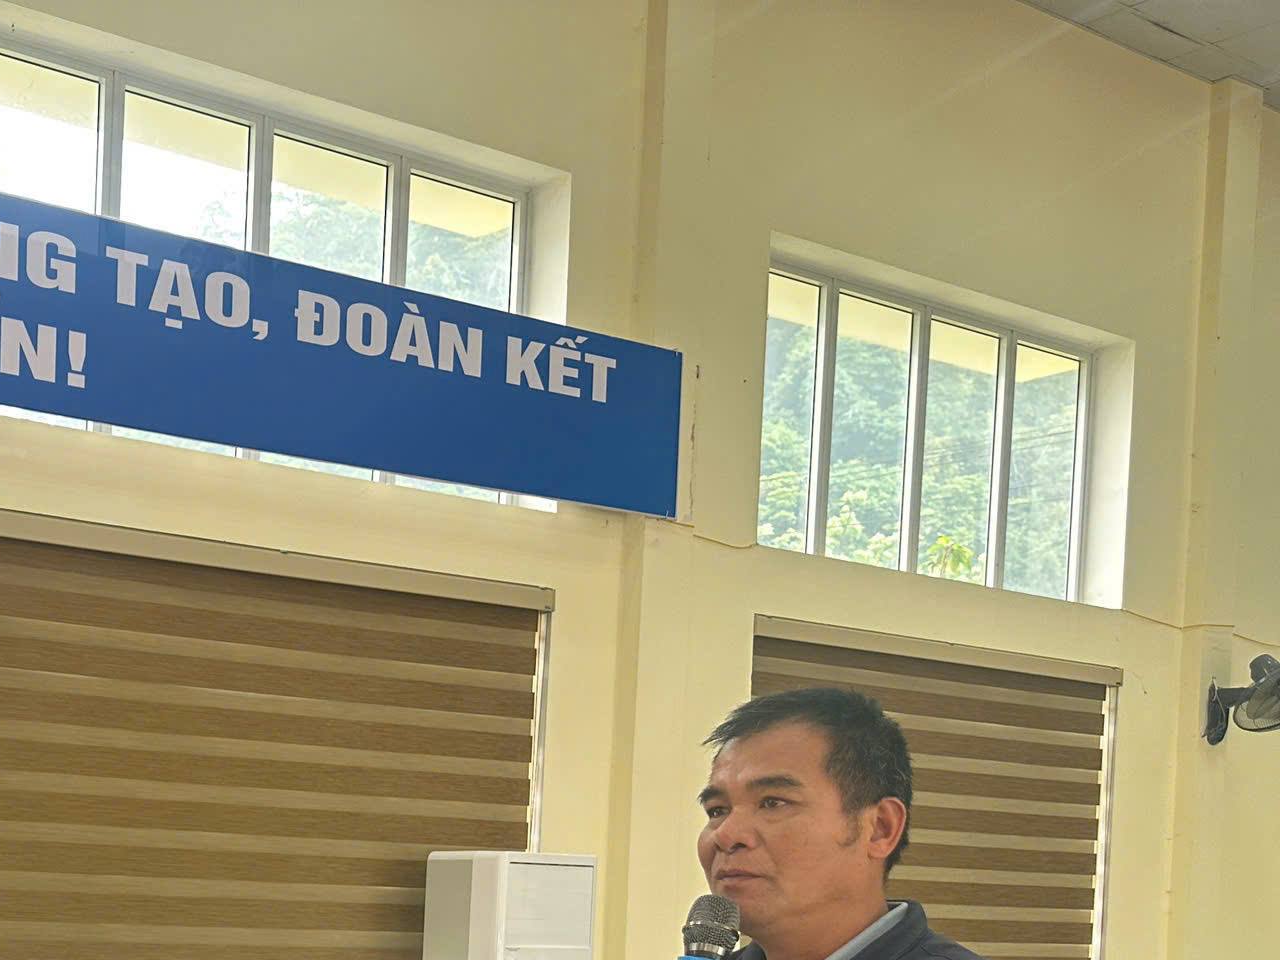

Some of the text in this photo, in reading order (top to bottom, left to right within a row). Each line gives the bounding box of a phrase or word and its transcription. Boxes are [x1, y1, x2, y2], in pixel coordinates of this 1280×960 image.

[106, 246, 269, 342] TẠO,
[294, 289, 484, 379] ĐOÀN
[506, 335, 618, 404] KẾT
